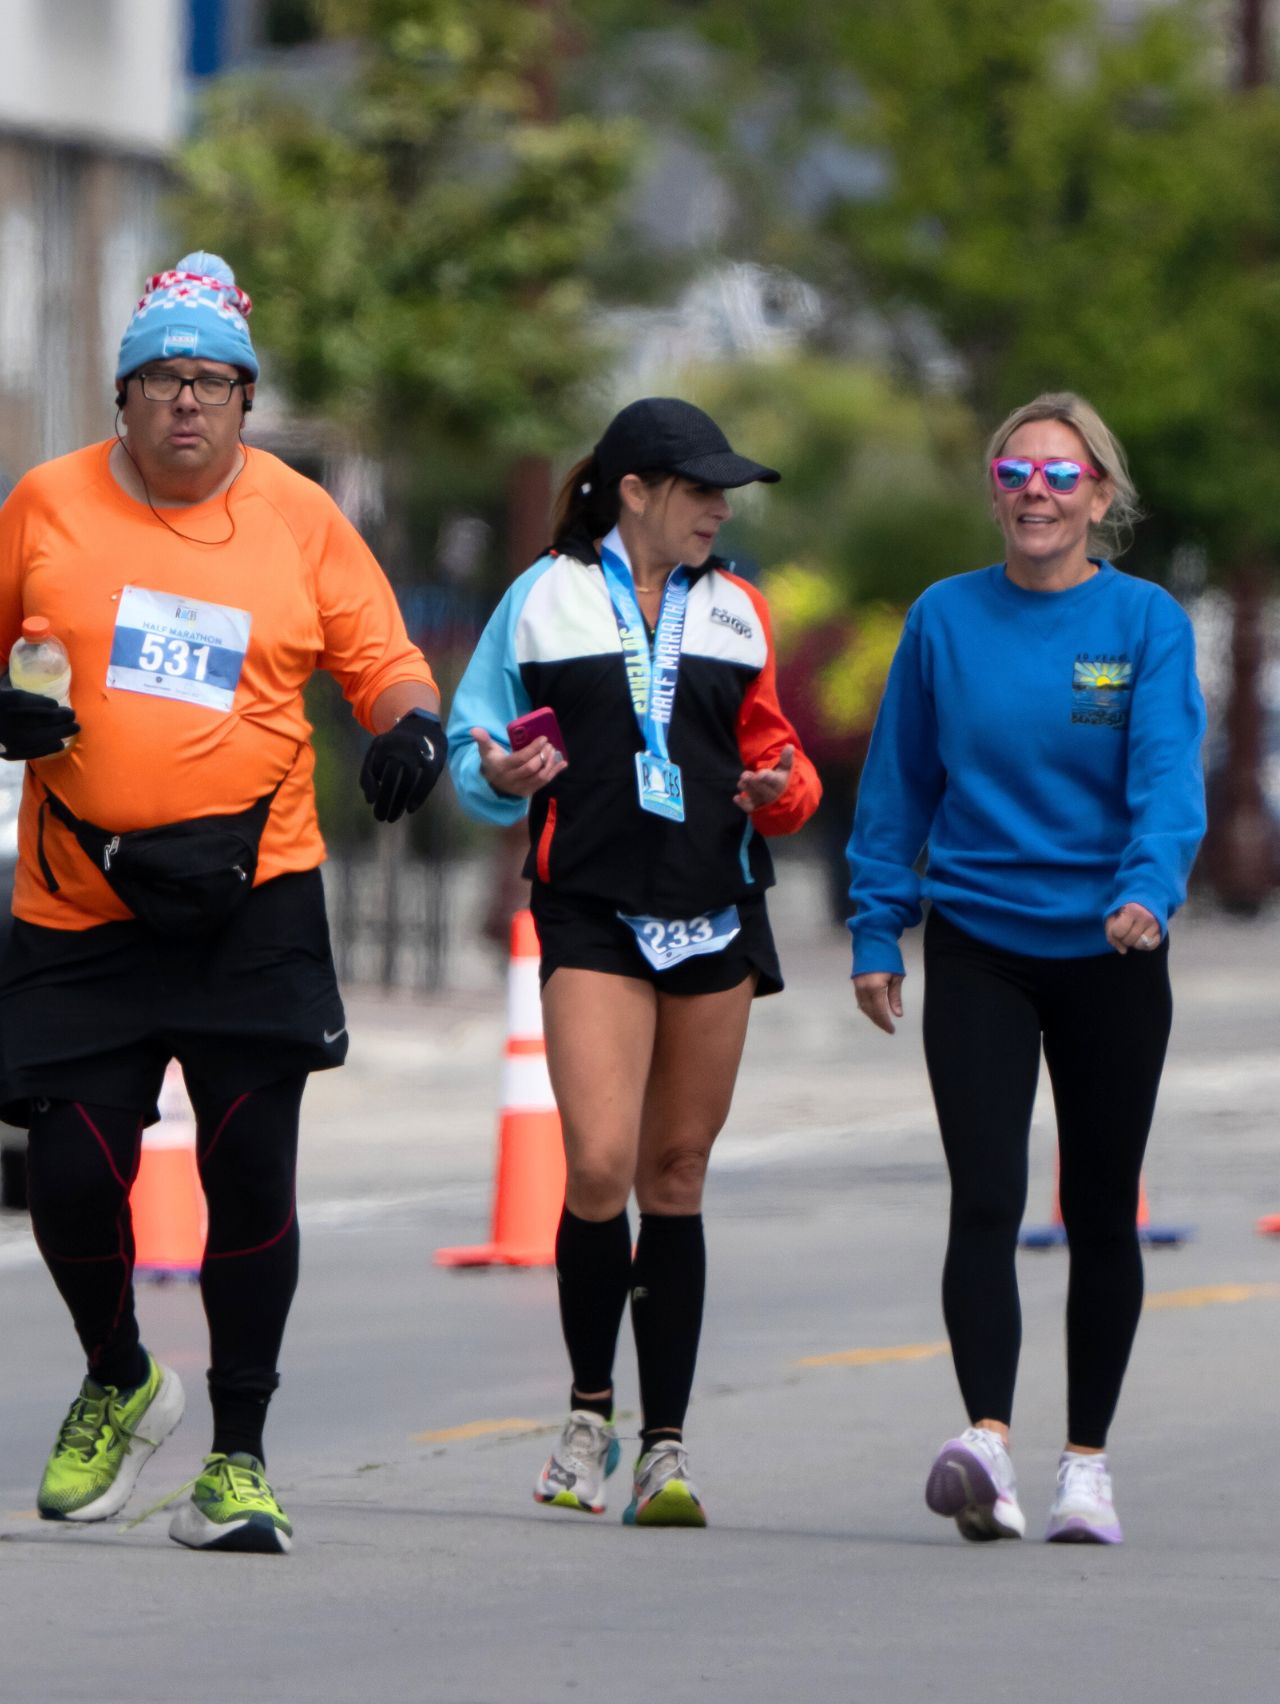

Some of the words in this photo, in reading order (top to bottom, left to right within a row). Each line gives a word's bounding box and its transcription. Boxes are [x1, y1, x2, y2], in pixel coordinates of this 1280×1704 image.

[142, 620, 168, 632] HALF
[169, 627, 223, 645] MARATHON
[710, 605, 753, 640] Fargo
[138, 633, 211, 682] 531
[650, 676, 677, 724] HALF
[643, 916, 714, 954] 233
